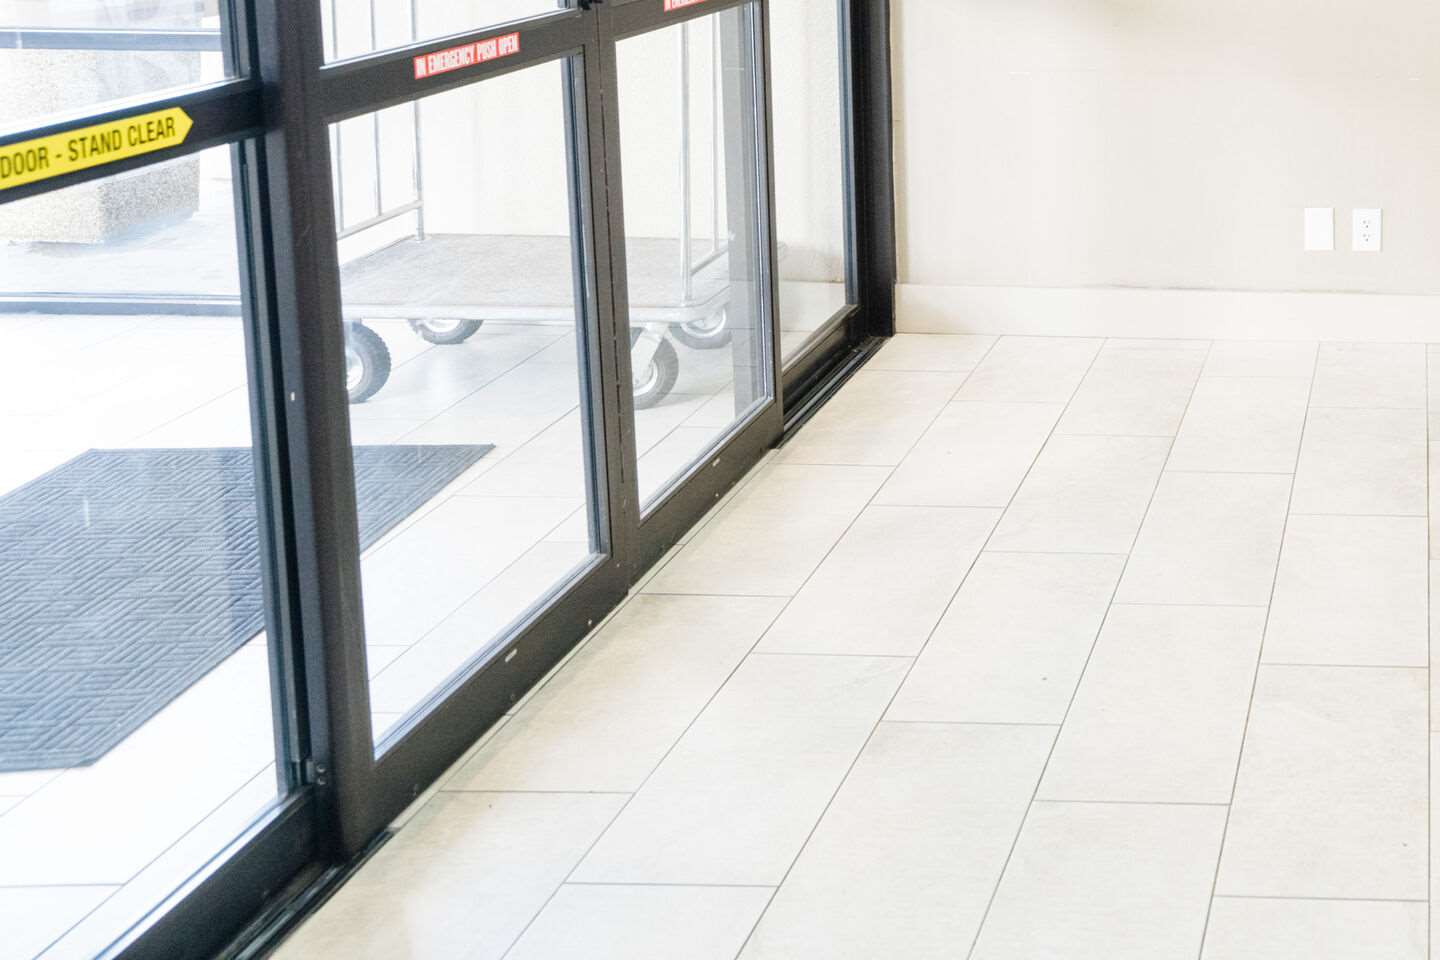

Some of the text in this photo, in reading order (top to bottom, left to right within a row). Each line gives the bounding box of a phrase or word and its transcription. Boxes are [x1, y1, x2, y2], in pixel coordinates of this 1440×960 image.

[427, 44, 476, 75] EMERGENCY
[477, 39, 497, 63] PUSH
[498, 33, 519, 54] OPEN
[0, 146, 50, 179] DOOR
[68, 130, 123, 162] STAND
[128, 116, 176, 147] CLEAR
